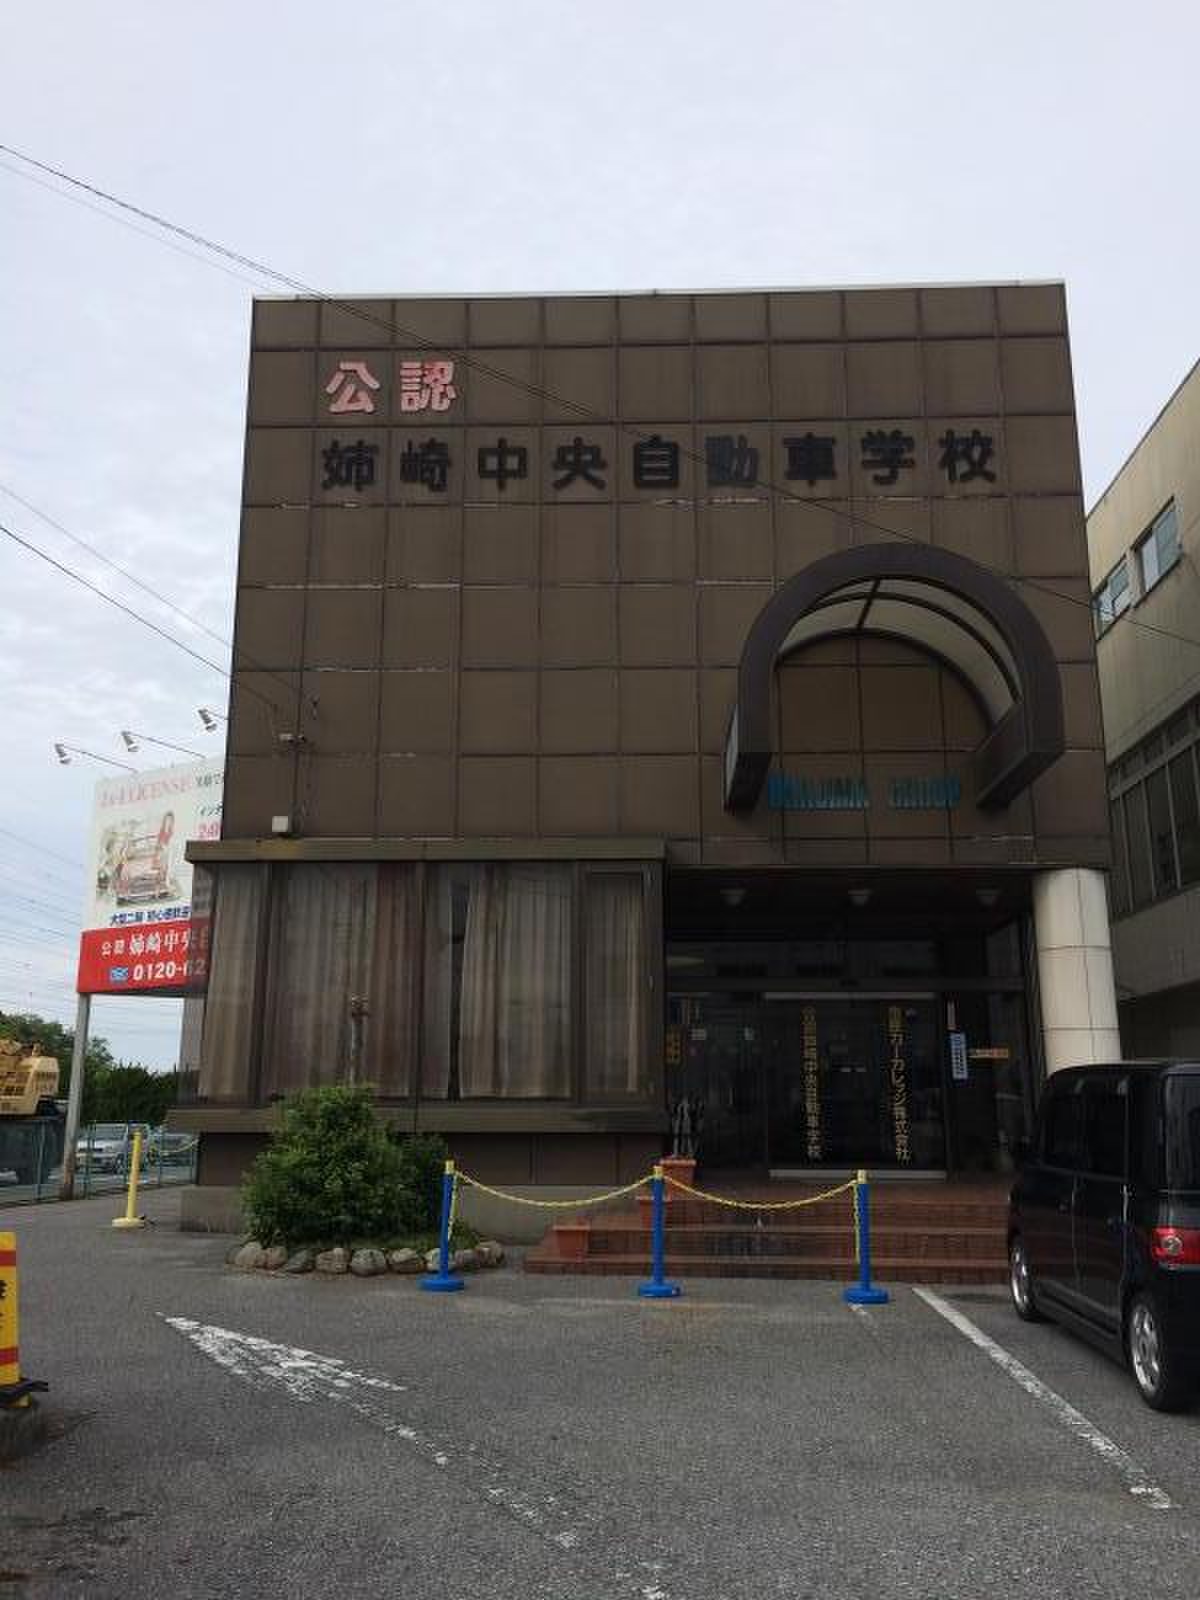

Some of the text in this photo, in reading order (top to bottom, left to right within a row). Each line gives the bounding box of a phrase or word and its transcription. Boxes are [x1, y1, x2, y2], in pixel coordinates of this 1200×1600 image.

[325, 360, 457, 414] 公認
[321, 428, 997, 493] 姉崎中央自動車学校
